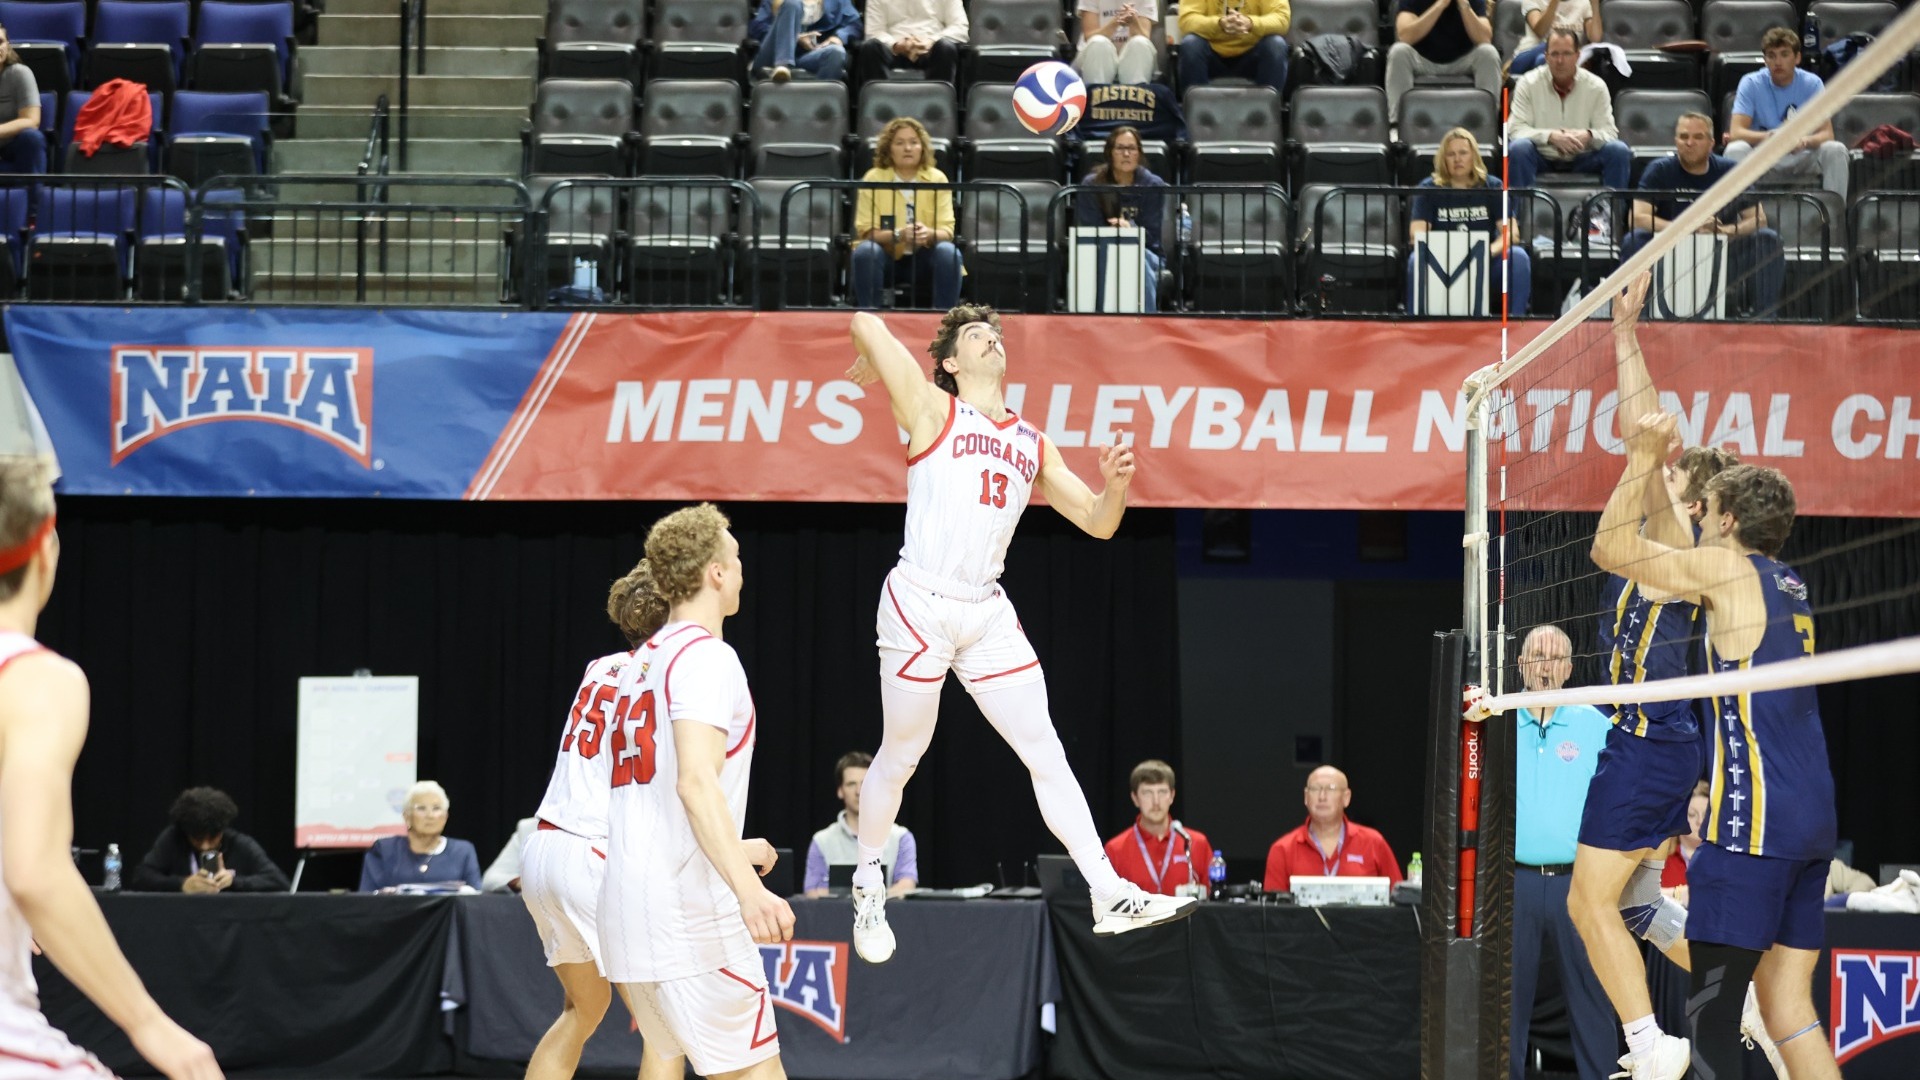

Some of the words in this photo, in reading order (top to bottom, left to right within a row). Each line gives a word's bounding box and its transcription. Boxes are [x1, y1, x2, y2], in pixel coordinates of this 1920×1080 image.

[1090, 107, 1155, 122] UNIVERSITY
[1076, 236, 1139, 313] T
[1418, 240, 1485, 316] M
[1657, 239, 1723, 320] U
[116, 350, 367, 457] NAIA
[606, 379, 866, 445] MEN'S
[899, 383, 1388, 453] LLEYBALL
[953, 432, 1035, 484] COUGARS
[980, 468, 1009, 509] 13
[562, 680, 618, 760] 15
[611, 689, 657, 788] 23
[757, 943, 841, 1033] IA
[1835, 953, 1920, 1058] N
